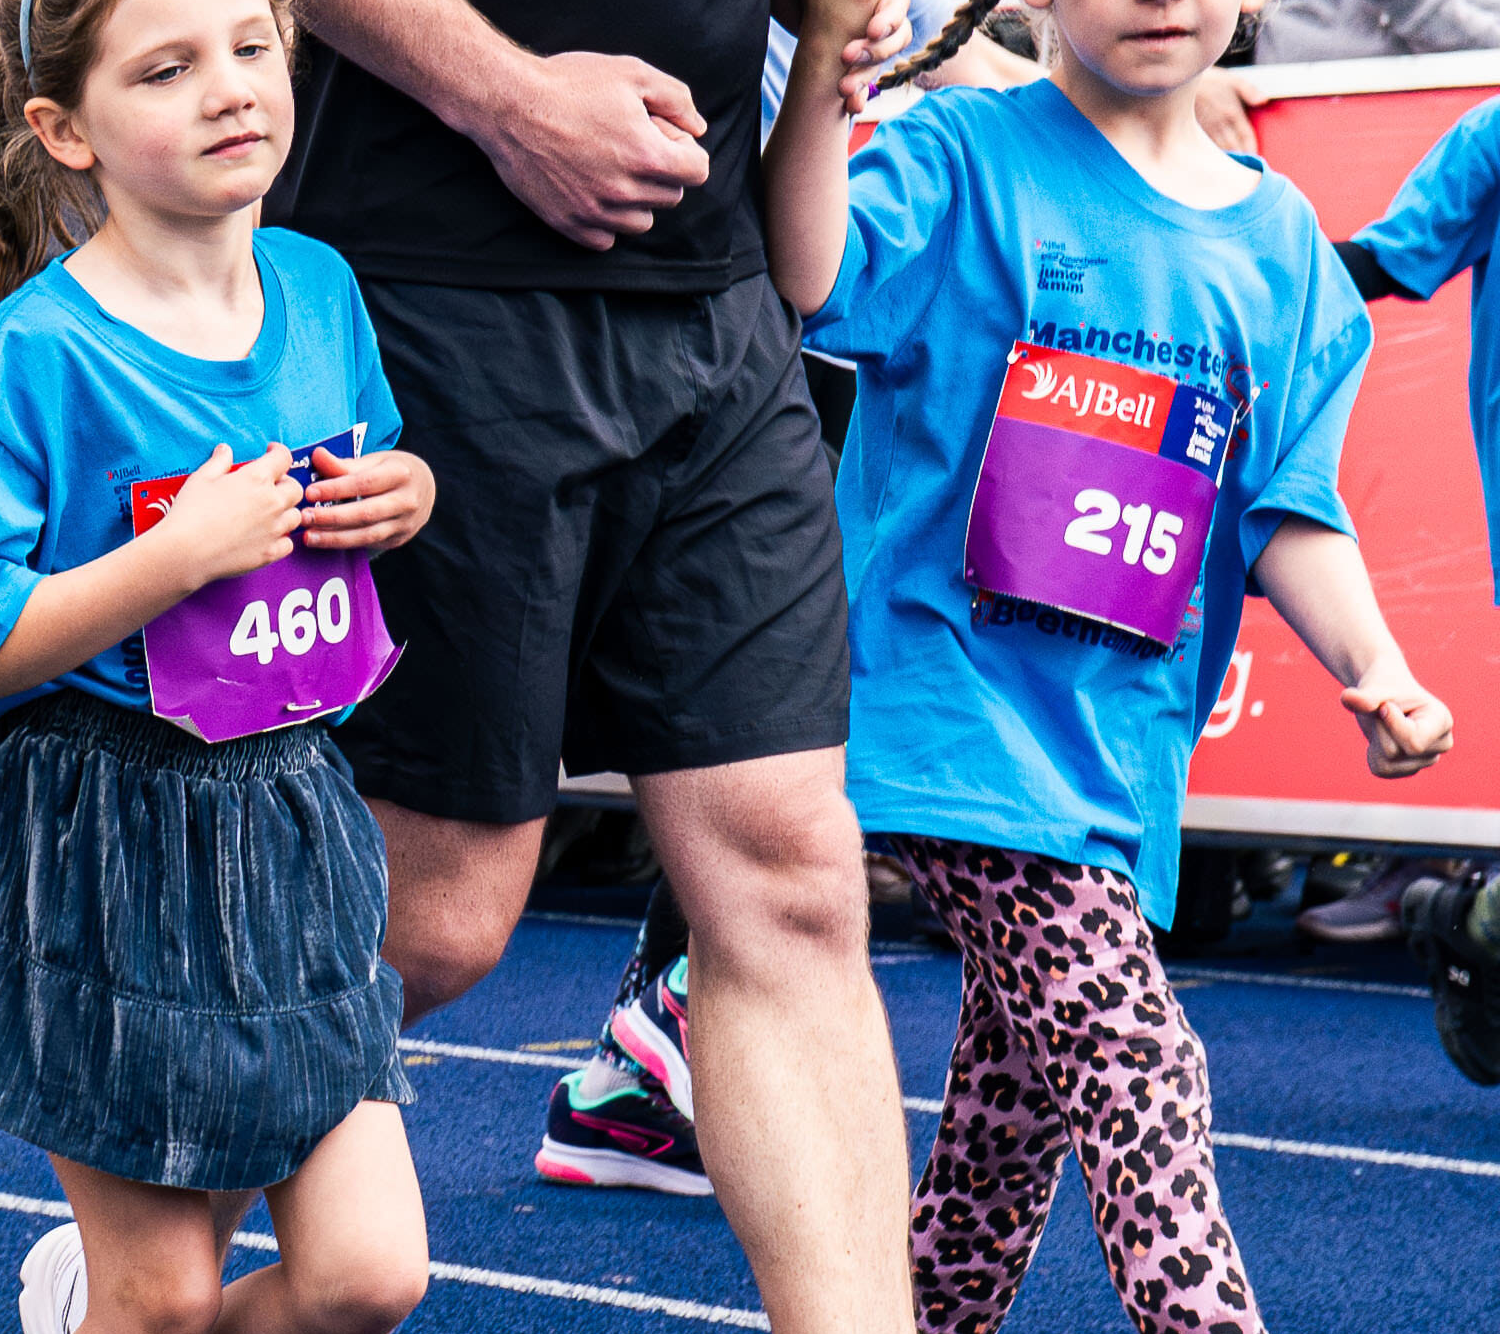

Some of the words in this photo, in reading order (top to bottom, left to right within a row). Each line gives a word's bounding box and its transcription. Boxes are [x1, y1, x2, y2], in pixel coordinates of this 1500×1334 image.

[1039, 264, 1085, 284] junior
[1063, 487, 1184, 576] 215
[229, 576, 351, 665] 460
